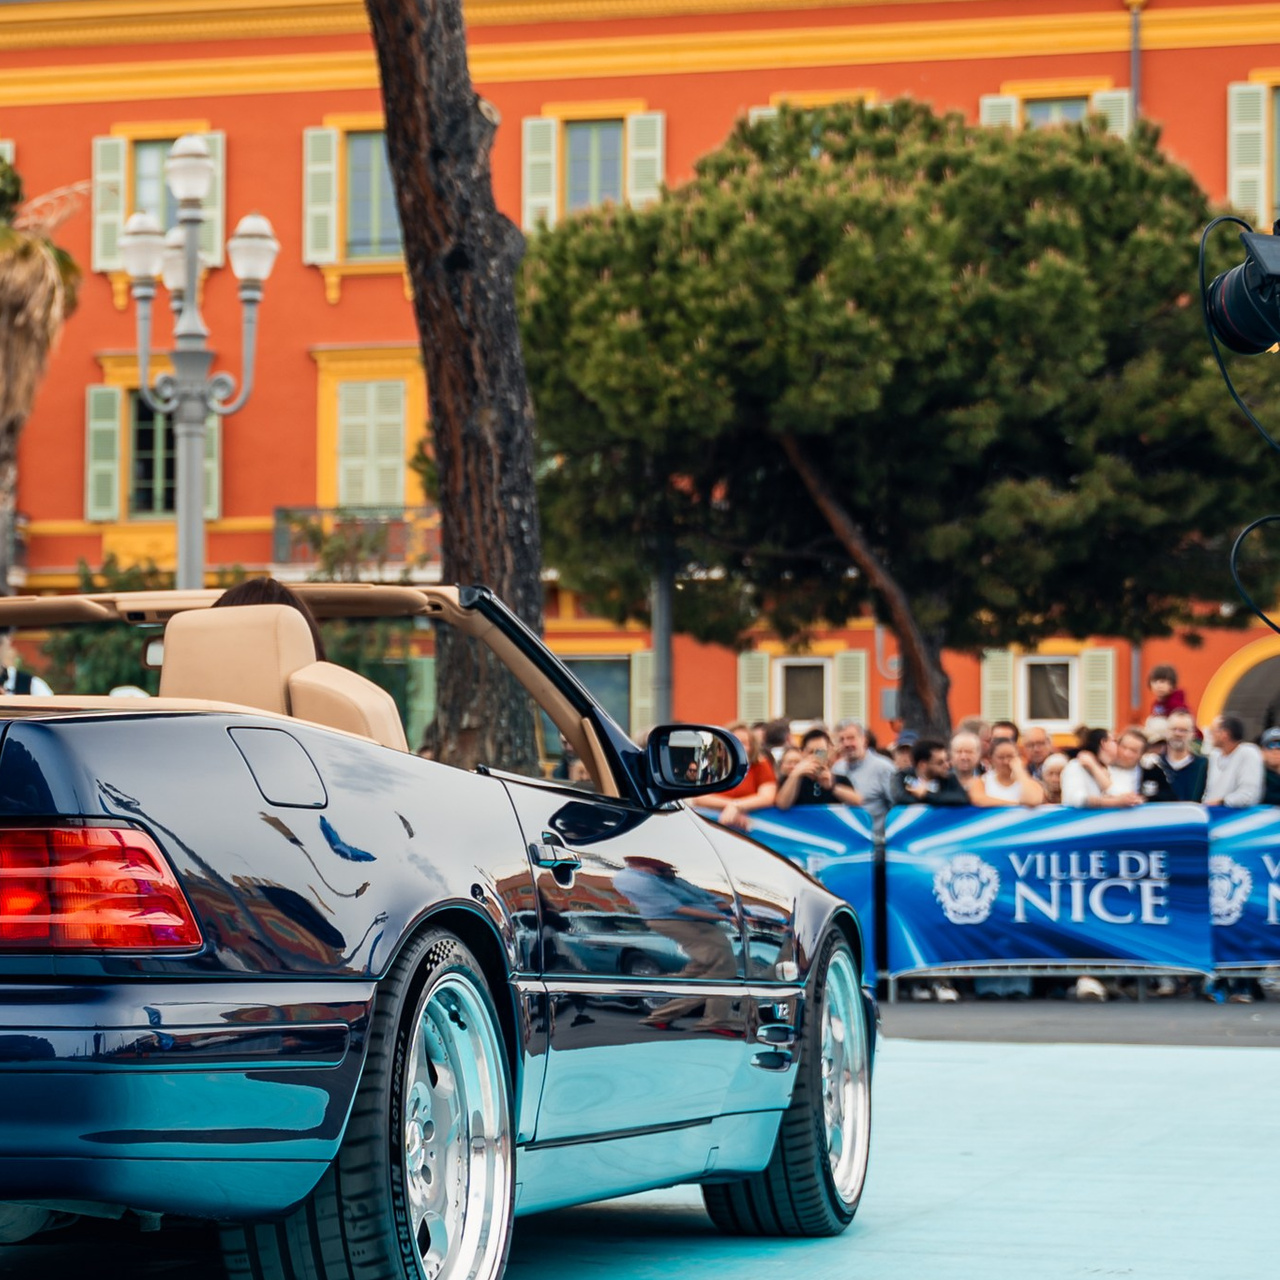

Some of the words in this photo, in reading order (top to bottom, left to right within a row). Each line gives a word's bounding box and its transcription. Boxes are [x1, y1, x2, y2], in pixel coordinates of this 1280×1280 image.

[1007, 850, 1109, 880] VILLE
[1118, 850, 1169, 880] DE
[1014, 878, 1170, 925] NICE
[393, 1040, 406, 1094] SPORT
[391, 1097, 400, 1145] PILOT
